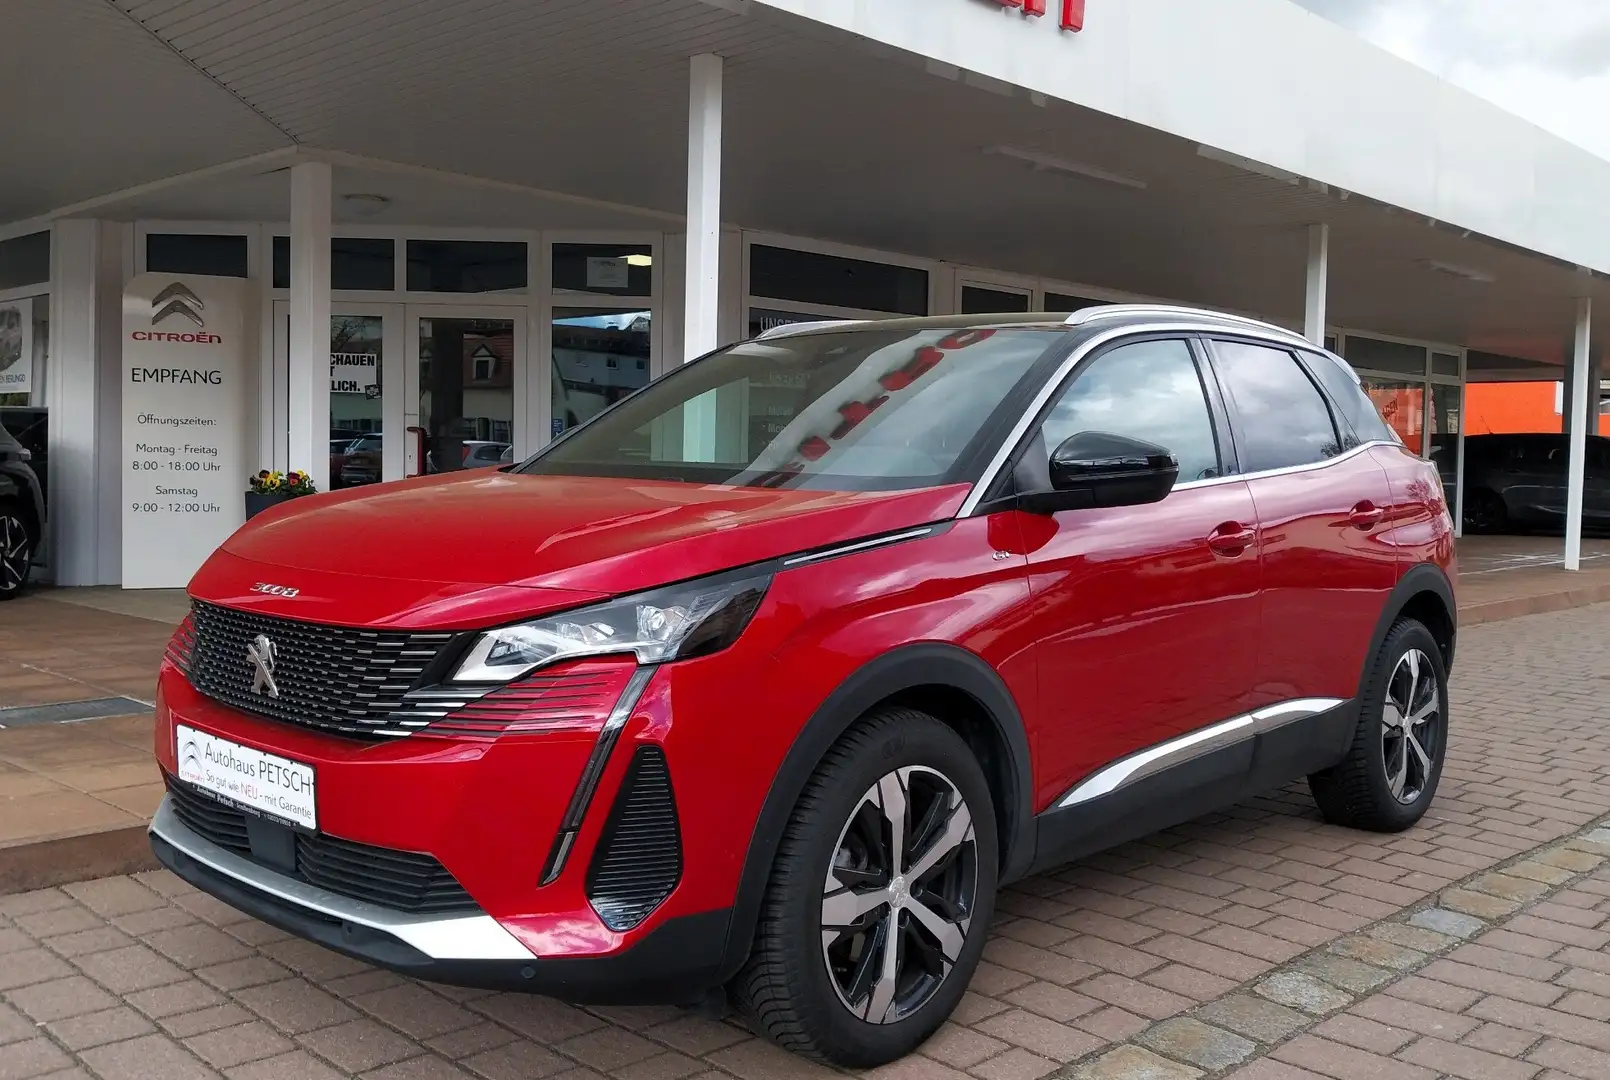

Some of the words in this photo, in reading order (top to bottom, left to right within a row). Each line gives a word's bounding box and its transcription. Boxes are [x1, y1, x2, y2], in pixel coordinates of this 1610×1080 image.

[131, 367, 222, 385] EMPFANG
[137, 412, 217, 427] Öffnungszeiten:
[136, 443, 175, 456] Montag
[184, 444, 218, 457] Freitag
[132, 461, 158, 470] 8:00
[168, 461, 200, 471] 18:00
[202, 461, 221, 471] Uhr
[155, 485, 198, 498] Samstag
[132, 502, 158, 512] 9:00
[168, 502, 200, 513] 12:00
[202, 502, 221, 513] Uhr
[249, 582, 300, 598] 3008
[205, 742, 255, 777] Autohaus
[259, 760, 311, 796] PETSCH
[206, 769, 215, 783] So
[216, 776, 227, 789] gut
[228, 779, 240, 792] wie
[240, 782, 258, 800] NEU
[264, 793, 277, 807] mit
[279, 796, 312, 819] Garantie
